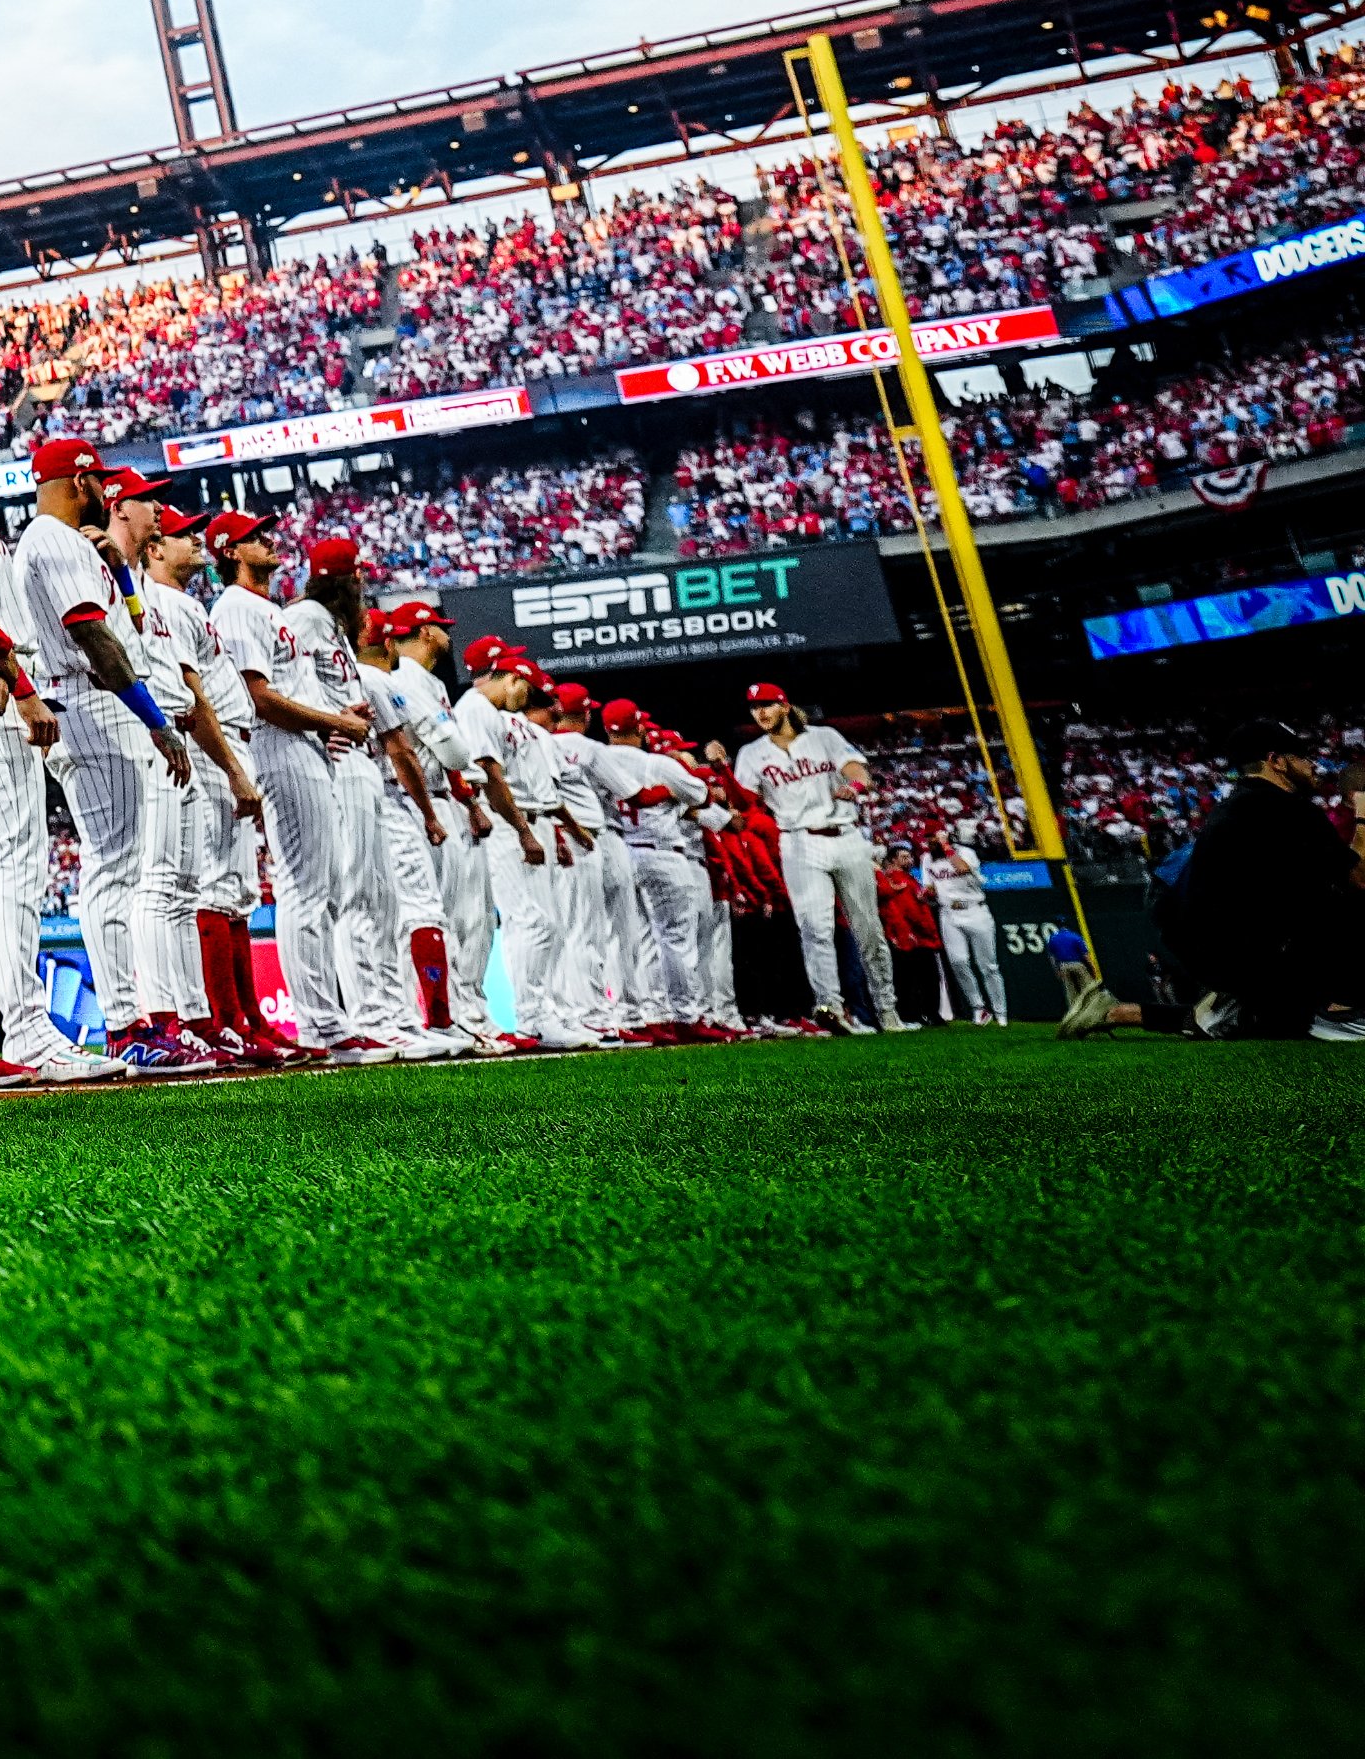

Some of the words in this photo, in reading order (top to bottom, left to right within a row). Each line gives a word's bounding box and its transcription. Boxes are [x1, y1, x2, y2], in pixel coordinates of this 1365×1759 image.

[1252, 220, 1365, 282] DODGERS
[707, 356, 758, 385] F.W.
[759, 343, 846, 376] WEBB
[847, 320, 1001, 364] COPANY
[512, 572, 672, 628] ESPN
[674, 557, 800, 611] BET
[551, 607, 779, 650] SPORTSBOOK
